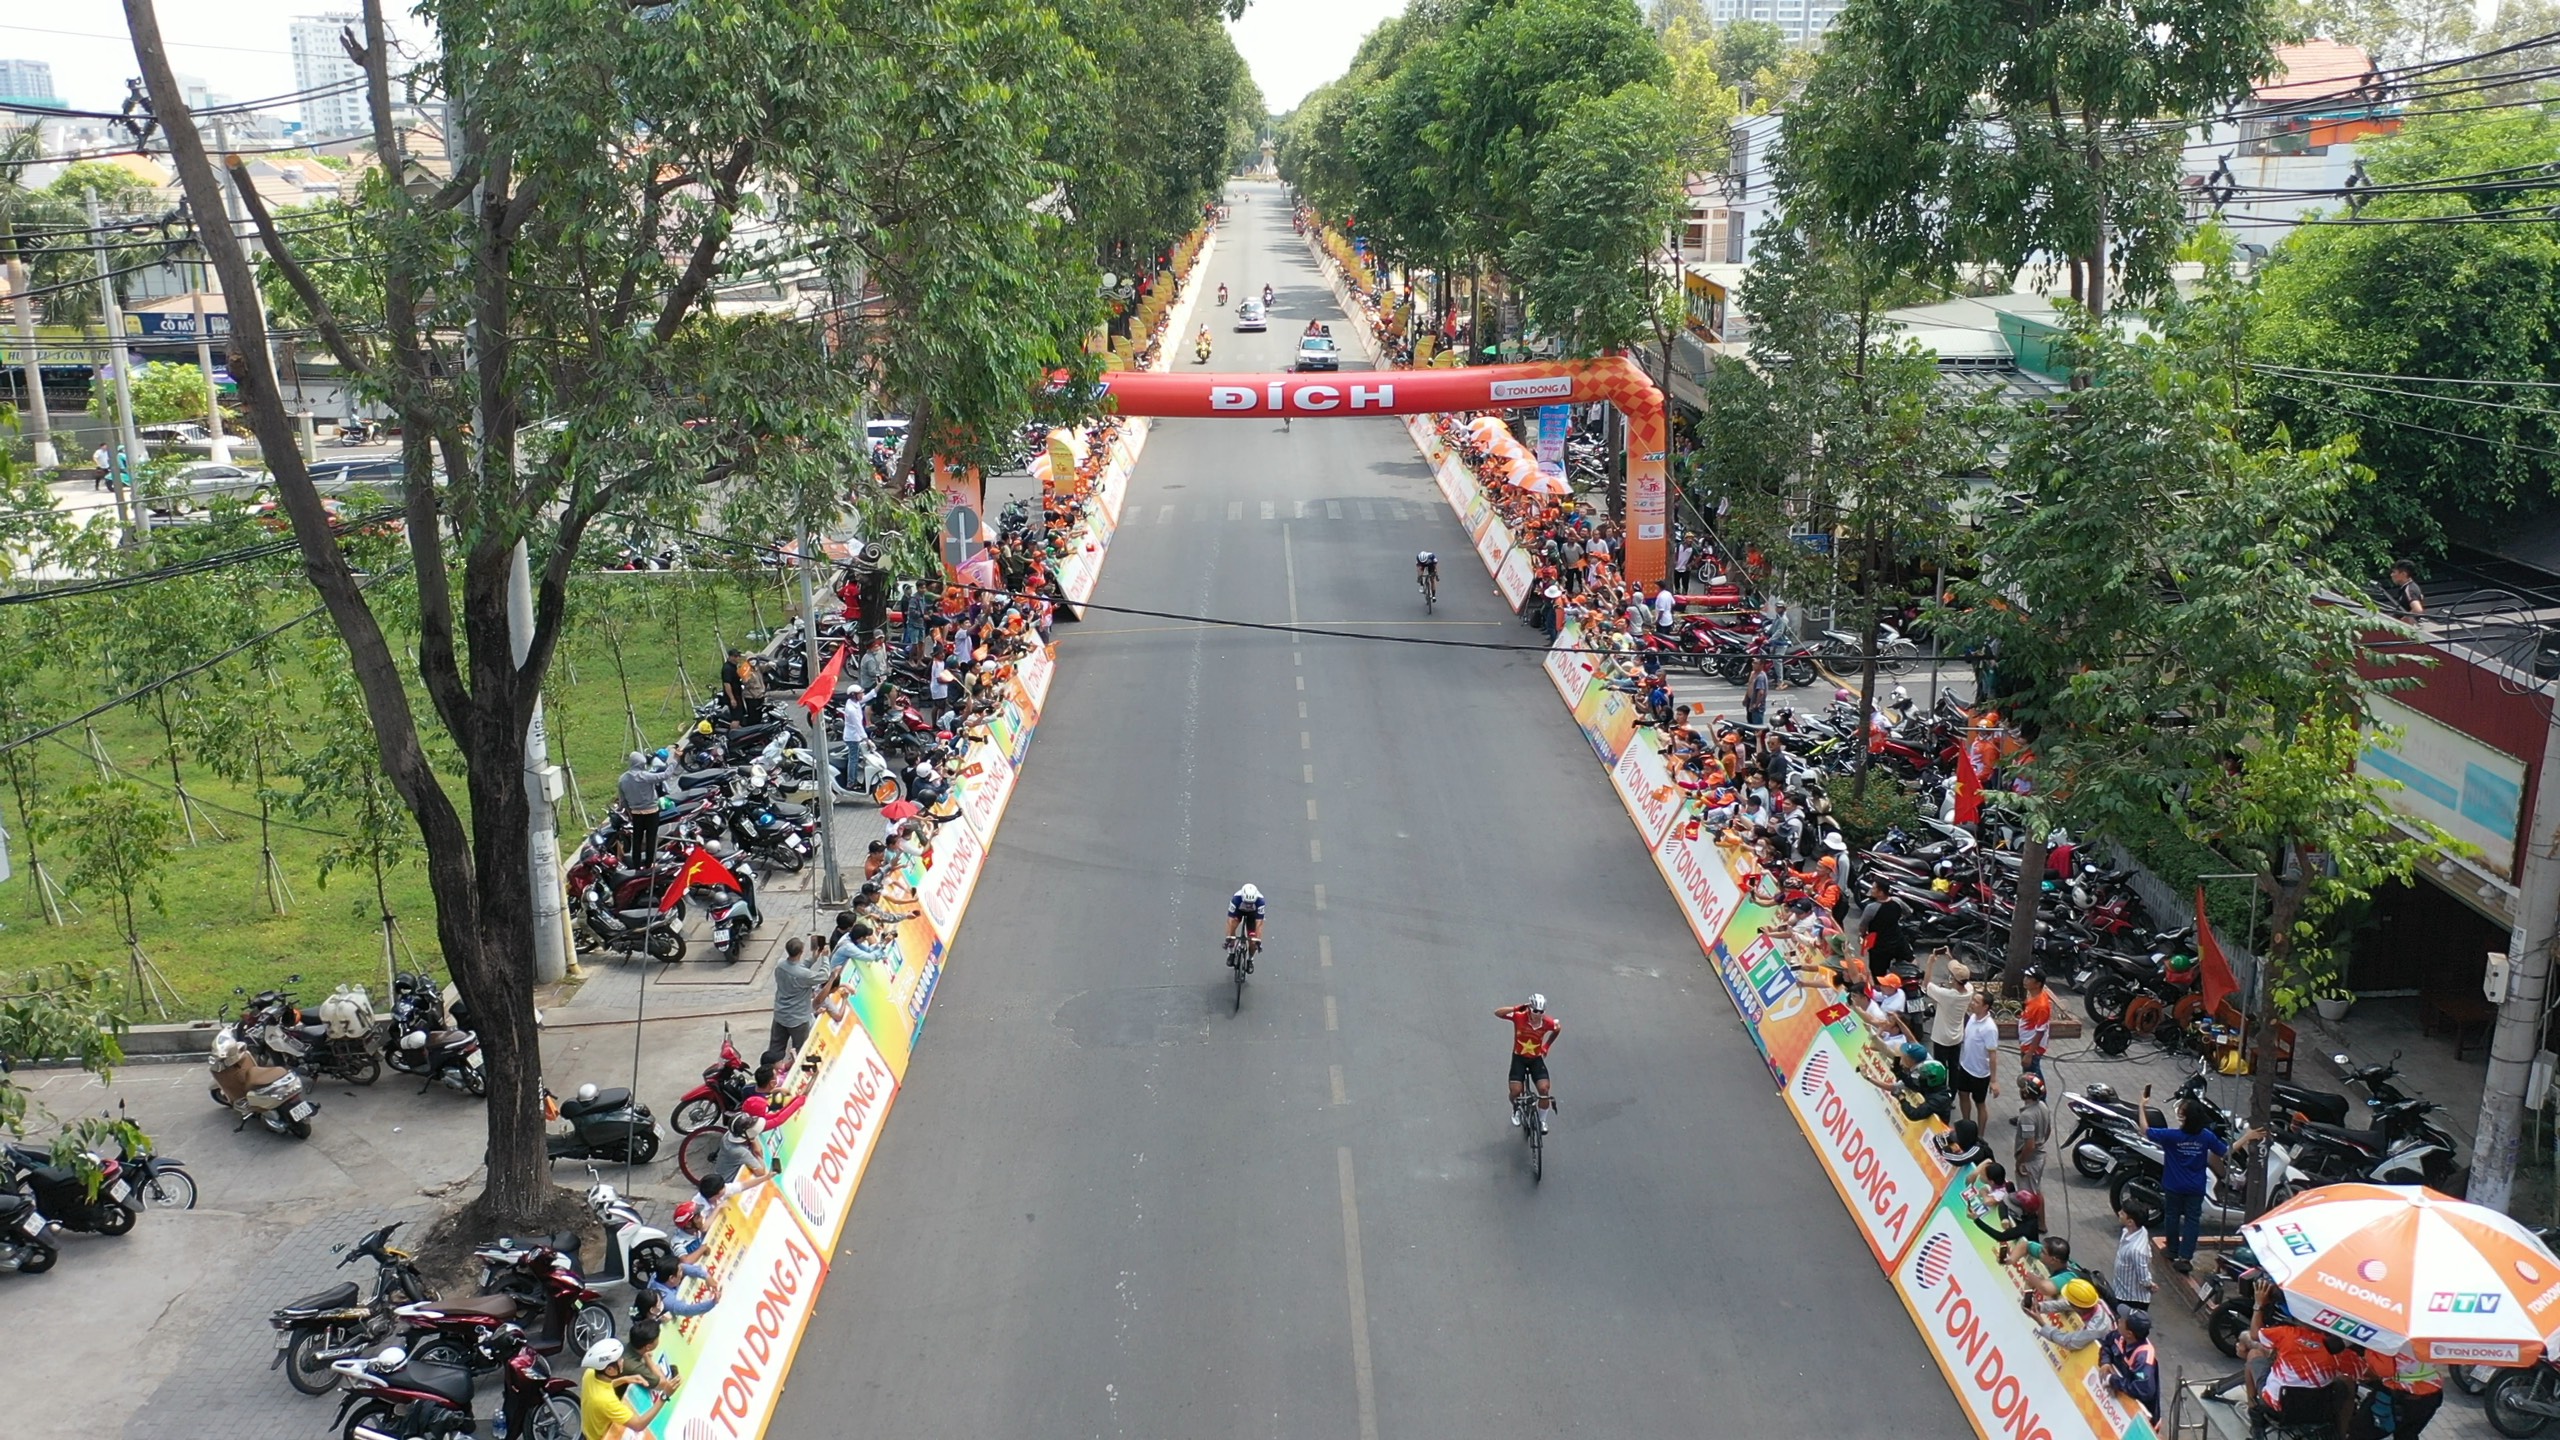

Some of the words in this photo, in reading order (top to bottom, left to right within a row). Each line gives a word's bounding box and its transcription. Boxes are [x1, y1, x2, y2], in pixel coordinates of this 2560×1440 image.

[64, 351, 84, 360] CON
[1209, 381, 1394, 410] ĐÍCH
[1507, 386, 1528, 396] TON
[1530, 384, 1558, 394] DONG
[1560, 383, 1568, 392] A
[976, 791, 992, 819] TON
[985, 768, 1005, 801] DONG
[997, 754, 1010, 773] A
[1626, 761, 1646, 795] TON
[1638, 782, 1663, 825] DONG
[1653, 813, 1668, 836] A
[936, 871, 956, 912] TON
[949, 834, 973, 883] DONG
[963, 828, 977, 848] A
[1672, 841, 1697, 884] TON
[1686, 867, 1719, 920] DONG
[1707, 907, 1724, 934] A
[813, 1132, 849, 1198] TON
[835, 1071, 876, 1150] DONG
[866, 1056, 884, 1088] A
[1815, 1080, 1854, 1147] TON
[1841, 1127, 1897, 1216] DONG
[1884, 1202, 1909, 1243] A
[2276, 1222, 2317, 1257] HTV
[2316, 1271, 2348, 1295] TON
[2347, 1284, 2391, 1311] DONG
[2390, 1302, 2404, 1315] A
[2428, 1292, 2501, 1313] HTV
[709, 1347, 761, 1439] TON
[743, 1258, 797, 1366] DONG
[785, 1237, 809, 1278] A
[1935, 1273, 1990, 1367] TON
[2312, 1308, 2378, 1343] HTV
[2448, 1348, 2470, 1357] TON
[2471, 1348, 2504, 1358] DONG
[2505, 1348, 2514, 1358] A
[2092, 1383, 2107, 1403] TON
[2102, 1399, 2122, 1426] DONG
[2117, 1423, 2127, 1434] A
